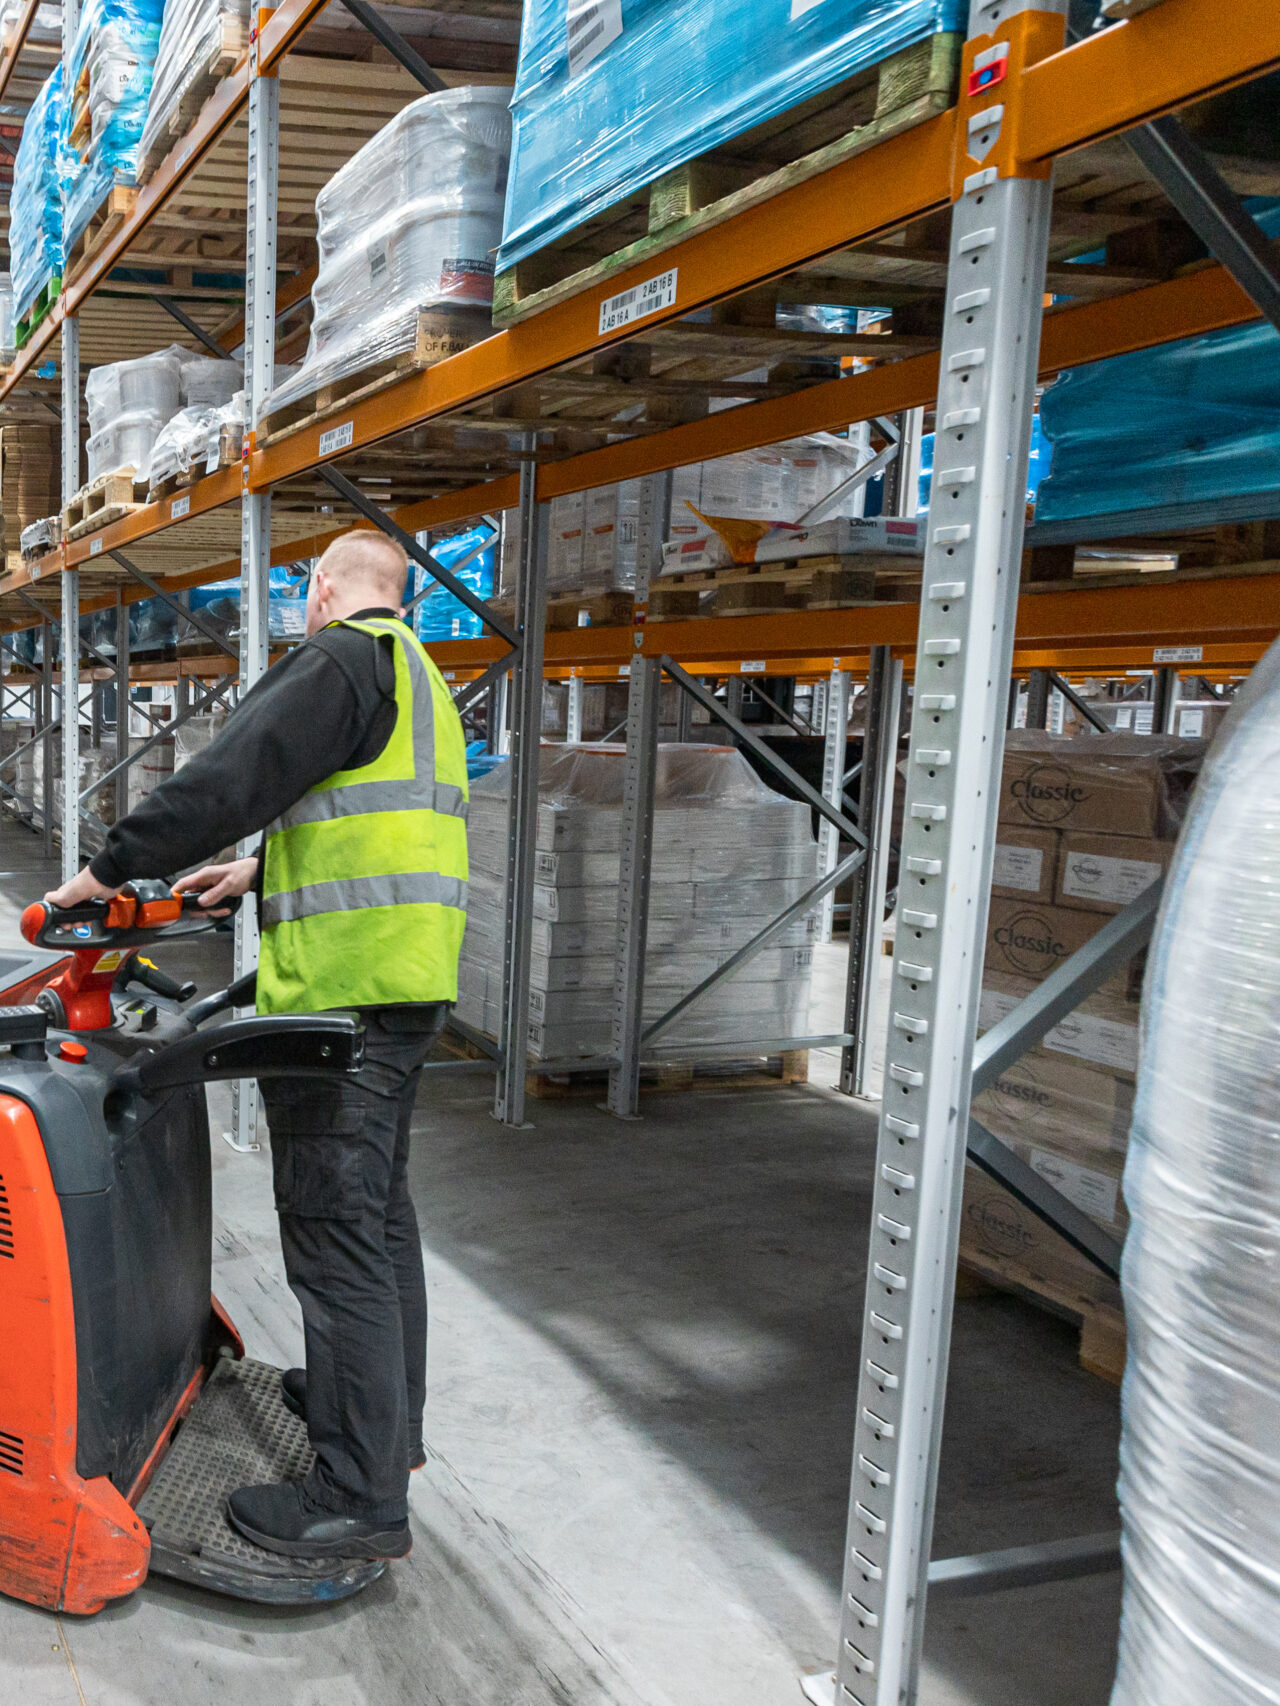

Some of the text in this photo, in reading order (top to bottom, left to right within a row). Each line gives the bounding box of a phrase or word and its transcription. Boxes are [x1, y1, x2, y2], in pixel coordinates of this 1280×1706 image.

[643, 273, 672, 297] 2 AB 16 B
[602, 319, 606, 330] 2
[607, 315, 615, 328] AB
[624, 309, 628, 321] A
[425, 342, 438, 352] OF
[1010, 779, 1094, 803] Classic
[993, 927, 1072, 957] Classic
